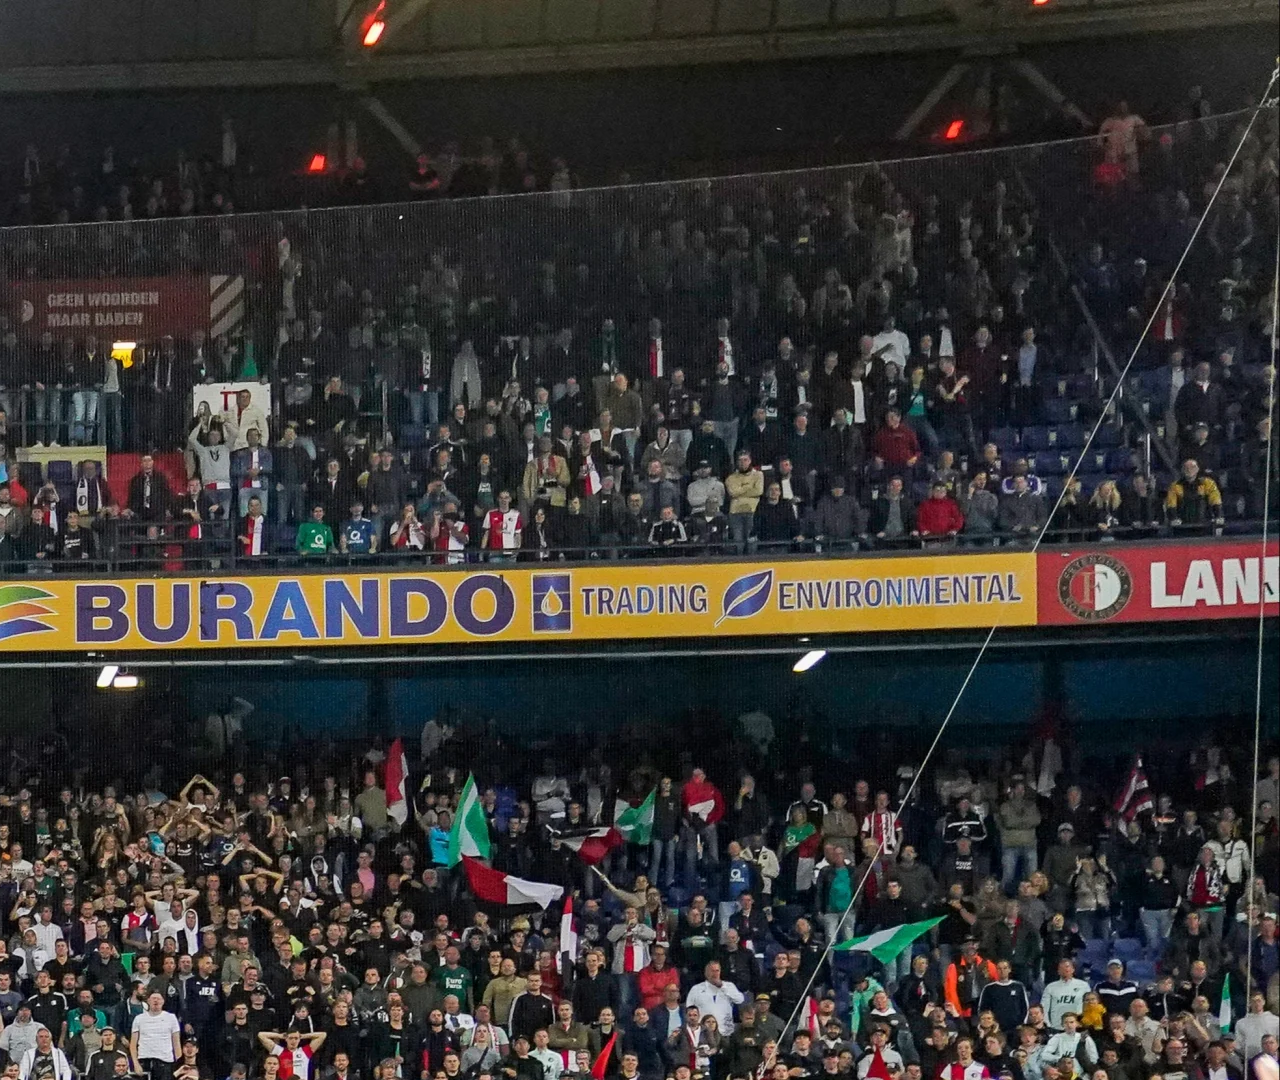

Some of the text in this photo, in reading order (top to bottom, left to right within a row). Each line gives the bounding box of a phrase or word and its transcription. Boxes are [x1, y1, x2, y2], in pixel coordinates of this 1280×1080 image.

[47, 291, 159, 308] GEEN WOORDEN
[47, 313, 91, 327] MAAR
[581, 583, 709, 617] TRADING
[778, 571, 1023, 611] ENVIRONMENTAL
[74, 573, 516, 645] BURANDO
